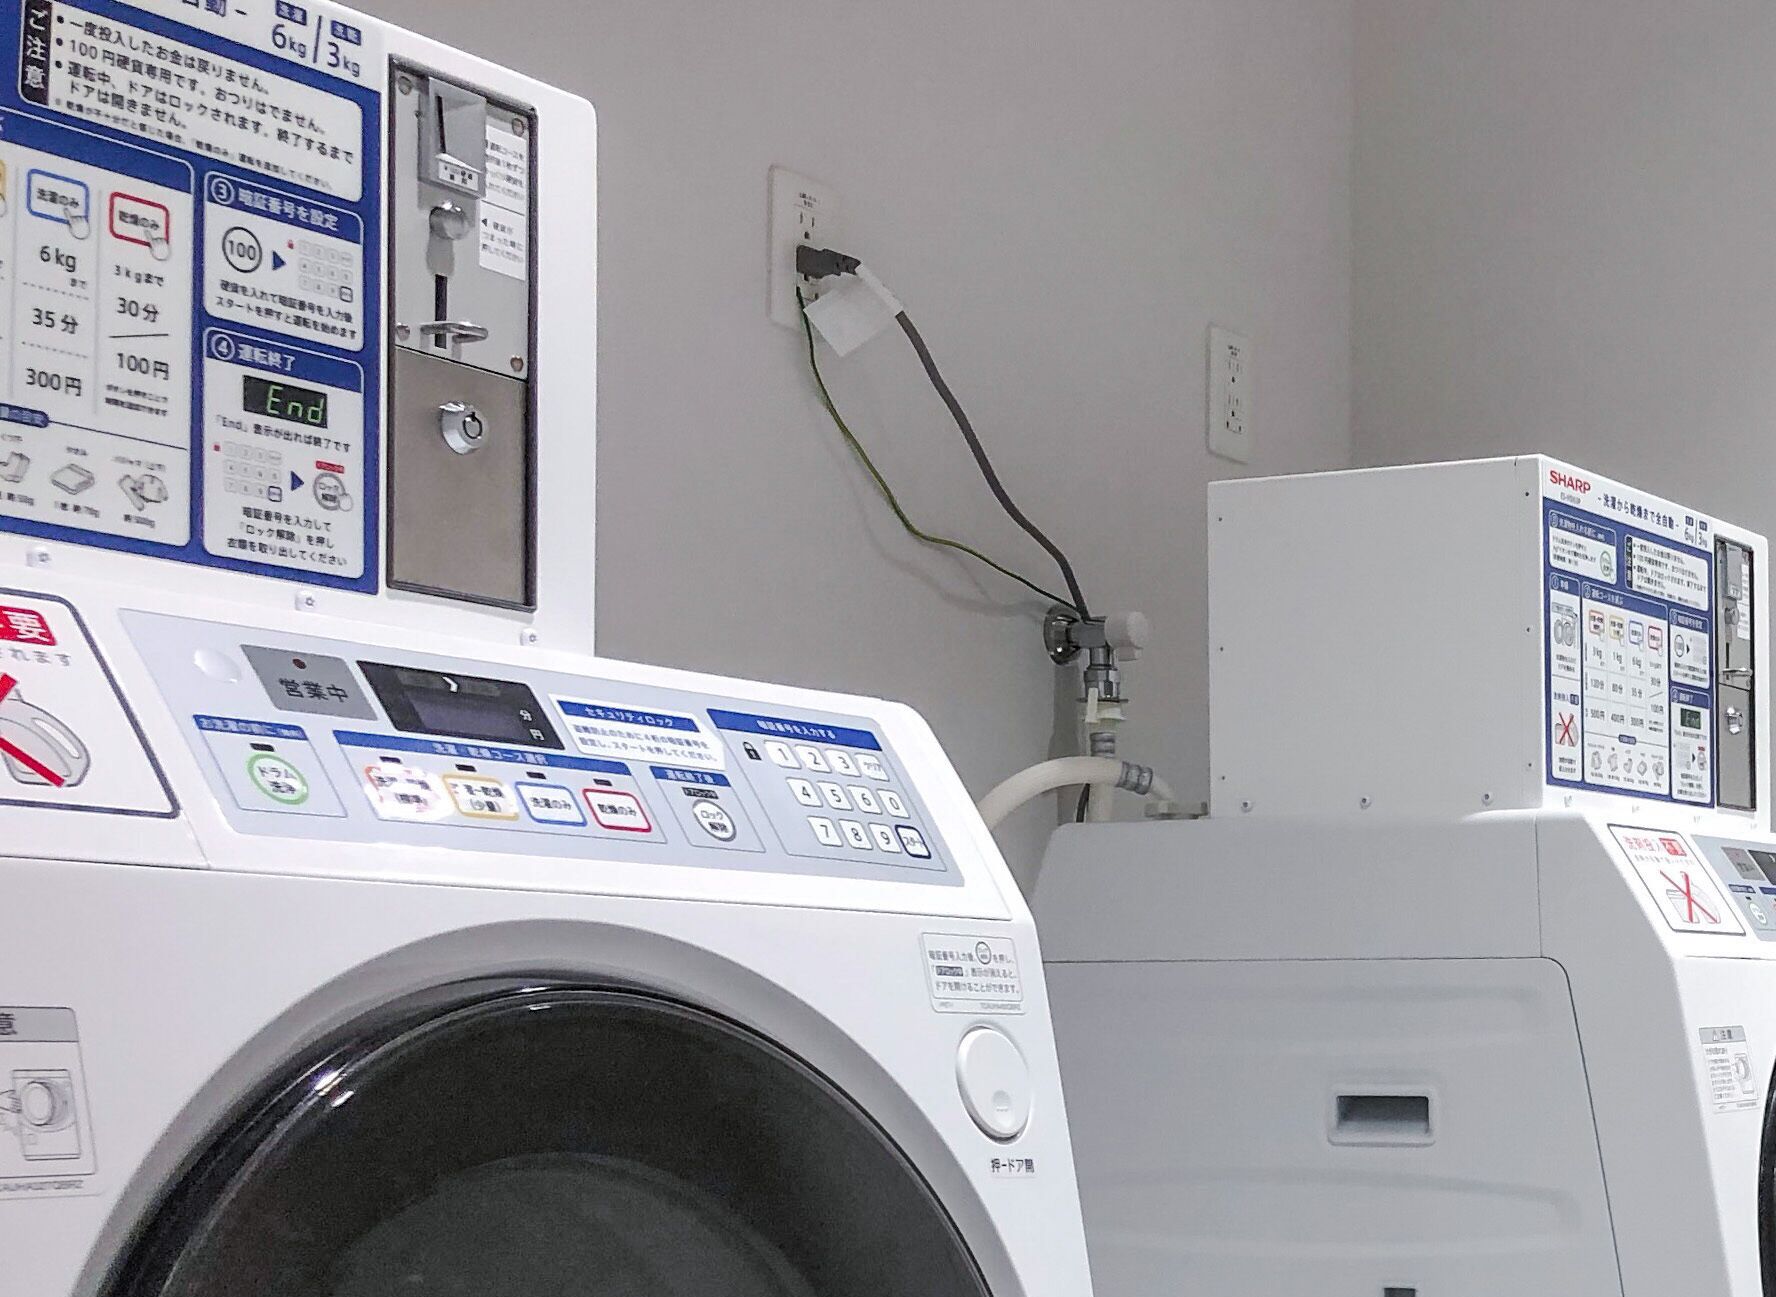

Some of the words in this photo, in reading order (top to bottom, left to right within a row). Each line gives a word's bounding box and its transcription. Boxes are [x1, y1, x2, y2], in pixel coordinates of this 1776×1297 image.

[229, 239, 257, 261] 100
[117, 352, 169, 381] 100円
[26, 367, 82, 397] 300円
[266, 385, 324, 424] End
[1549, 470, 1591, 495] SHARP
[0, 646, 71, 667] れます
[278, 677, 349, 703] 営業中
[776, 747, 789, 761] 1
[807, 752, 821, 766] 2
[837, 756, 850, 769] 3
[801, 786, 812, 799] 4
[830, 789, 842, 803] 5
[861, 793, 872, 807] 6
[888, 797, 900, 810] 0
[819, 824, 831, 838] 7
[850, 827, 862, 842] 8
[879, 831, 890, 845] 9
